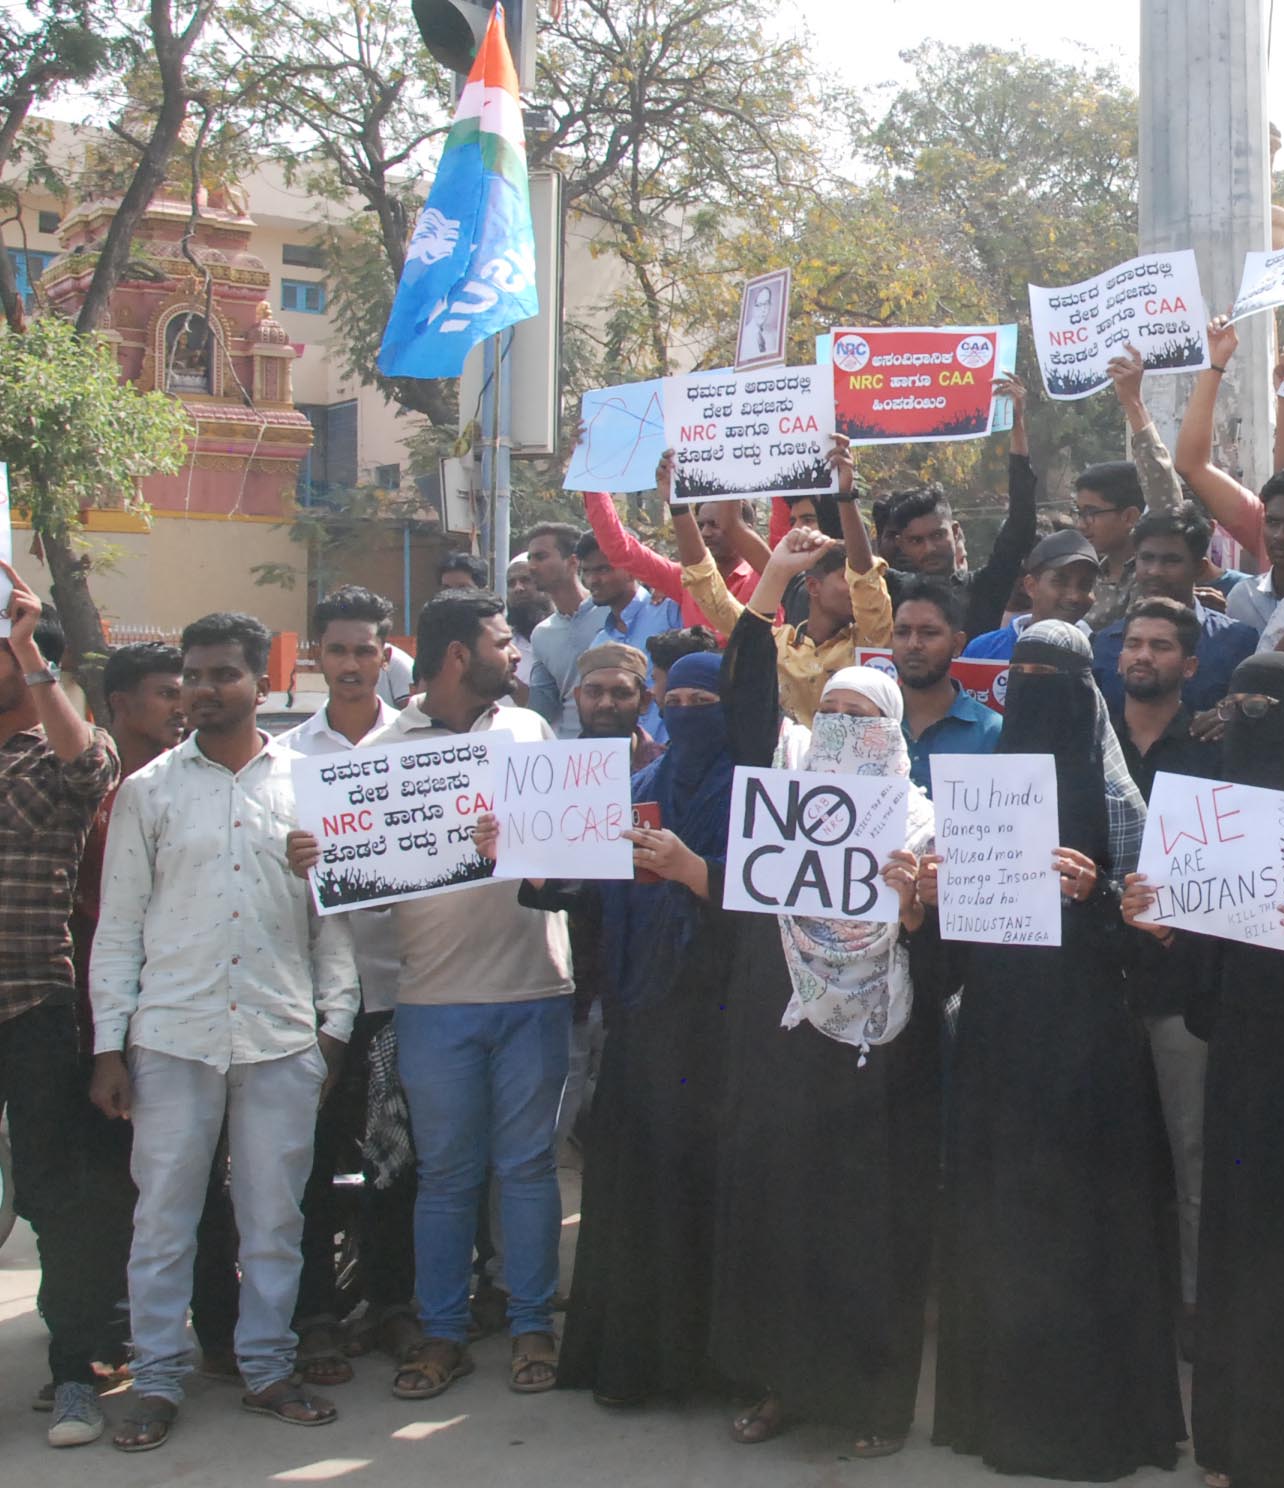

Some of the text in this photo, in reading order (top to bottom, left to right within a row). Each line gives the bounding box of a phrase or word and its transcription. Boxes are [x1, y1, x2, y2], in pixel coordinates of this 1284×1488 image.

[1049, 284, 1100, 311] ಧರ್ಮದ
[1048, 327, 1089, 347] NRC
[1144, 296, 1187, 316] CAA
[1069, 304, 1099, 325] ದೇಶ
[961, 342, 989, 351] CAA
[687, 381, 736, 402] ಧರ್ಮದ
[849, 374, 884, 390] NRC
[938, 371, 975, 386] CAA
[703, 402, 733, 419] ದೇಶ
[680, 415, 819, 442] NRC ಹಾಗೂ CAA
[320, 755, 389, 785] ಧರ್ಮದ
[504, 750, 620, 802] NO NRC
[349, 781, 389, 805] ದೇಶ
[322, 809, 374, 838] NRC
[384, 802, 444, 826] ಹಾಗೂ
[742, 777, 857, 846] NO
[808, 797, 830, 819] CAB
[1160, 785, 1245, 855] WE
[508, 810, 553, 848] NO
[561, 803, 621, 843] CAB
[823, 814, 843, 835] NRC
[398, 829, 438, 856] ರದ್ದು
[1170, 848, 1205, 876] ARE
[742, 844, 879, 916] CAB
[1153, 866, 1278, 921] INDIANS
[946, 912, 1032, 932] HINDUSTANI
[1228, 902, 1277, 924] KILL THE
[1002, 931, 1048, 943] BANEGA
[1245, 922, 1277, 938] BILL
